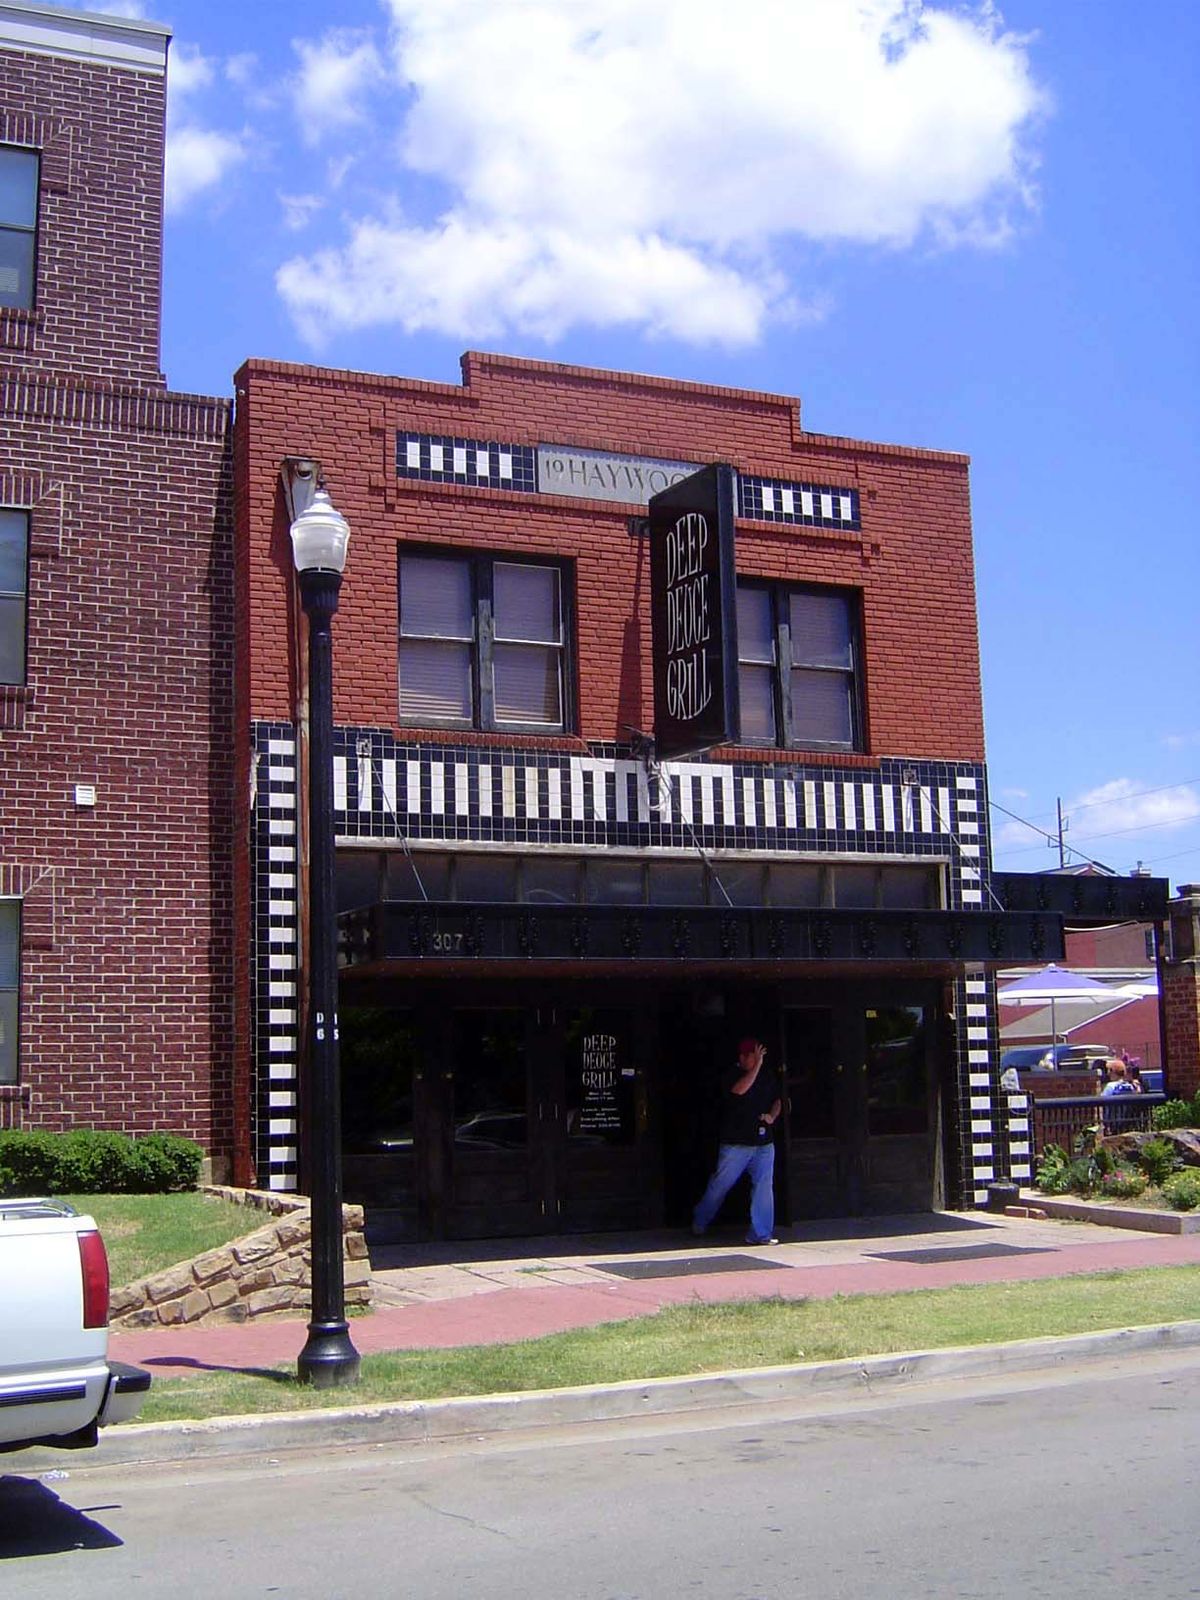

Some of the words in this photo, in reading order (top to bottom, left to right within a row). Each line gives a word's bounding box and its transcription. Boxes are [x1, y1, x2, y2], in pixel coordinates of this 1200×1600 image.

[666, 512, 708, 589] DEEP
[667, 574, 710, 655] DEUCE
[667, 649, 712, 721] GRILL
[432, 933, 463, 950] 307
[583, 1034, 617, 1051] DEEP
[582, 1071, 617, 1088] GRILL
